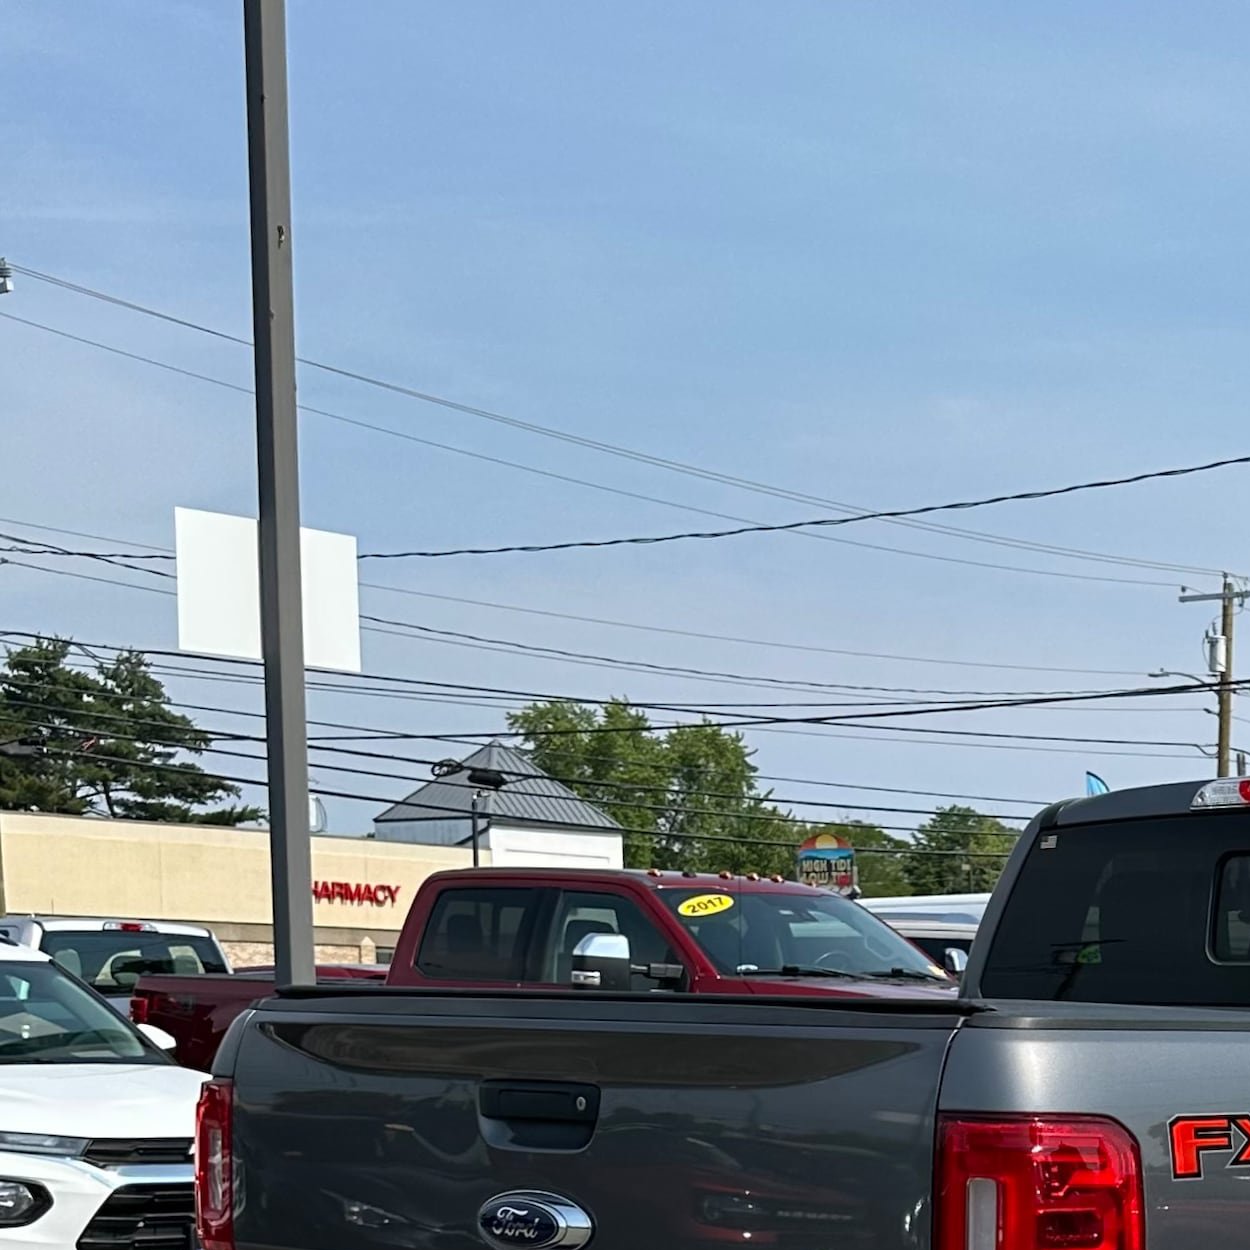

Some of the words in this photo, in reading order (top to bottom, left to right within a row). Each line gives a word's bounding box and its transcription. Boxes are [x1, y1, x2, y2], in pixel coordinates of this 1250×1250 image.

[311, 881, 399, 907] HARMACY
[687, 896, 723, 913] 2017
[492, 1206, 540, 1239] Ford
